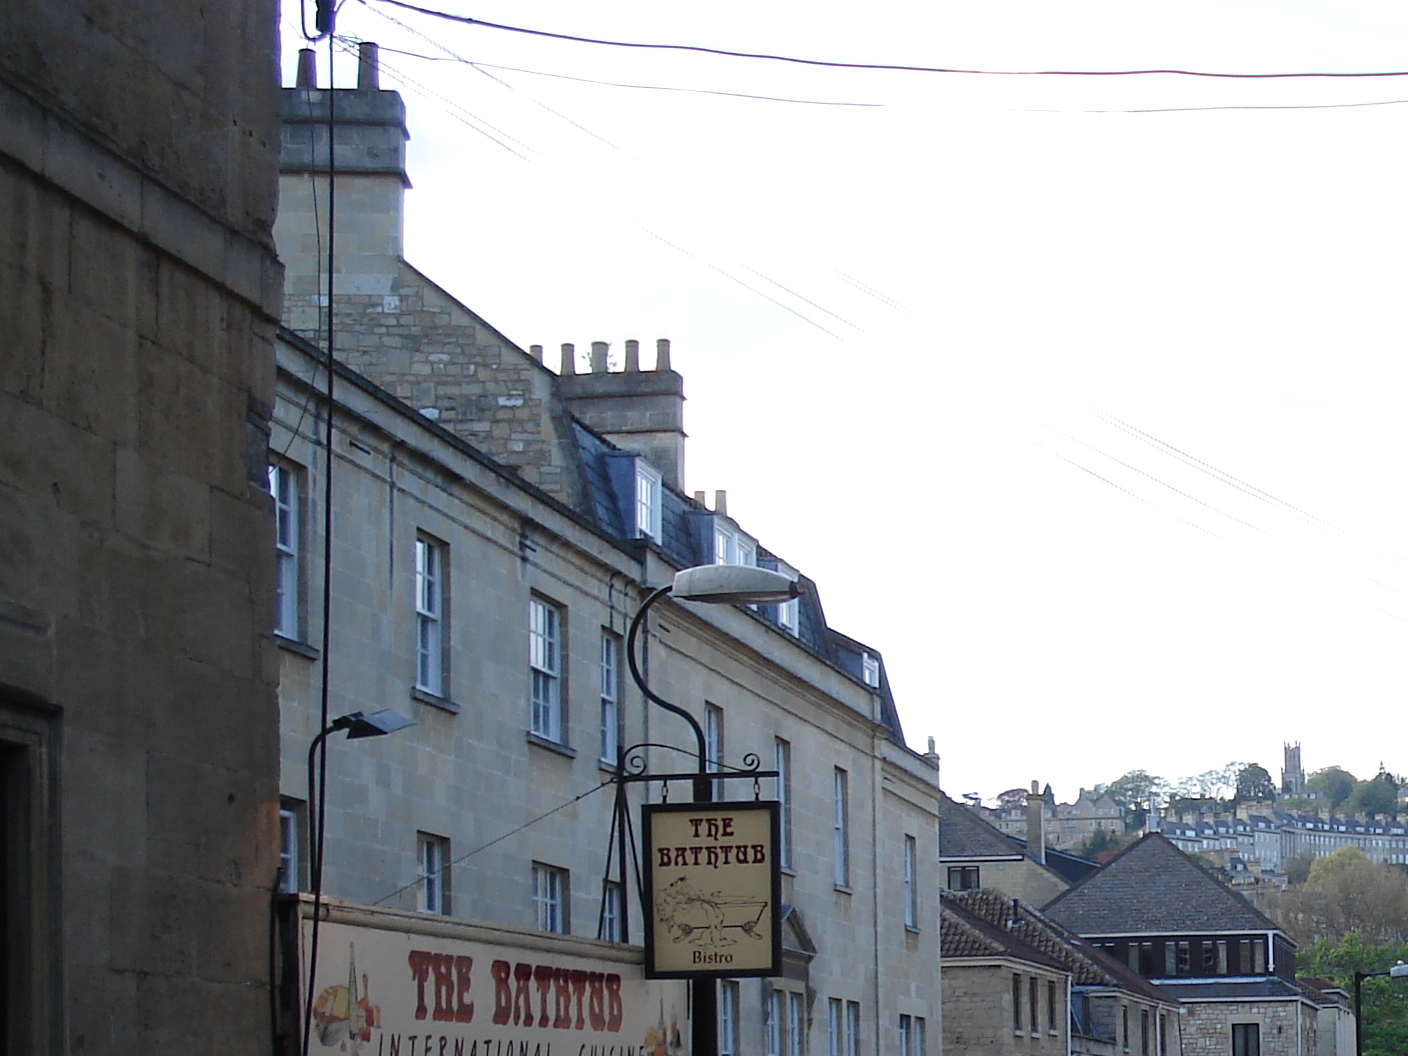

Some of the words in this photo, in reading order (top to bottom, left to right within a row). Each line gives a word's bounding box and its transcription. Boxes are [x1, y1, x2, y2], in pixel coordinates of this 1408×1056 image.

[689, 817, 735, 841] THE
[657, 844, 766, 869] BATHTUB
[692, 950, 734, 965] Bistro
[408, 949, 475, 1024] THE
[490, 959, 623, 1033] BATHTUB
